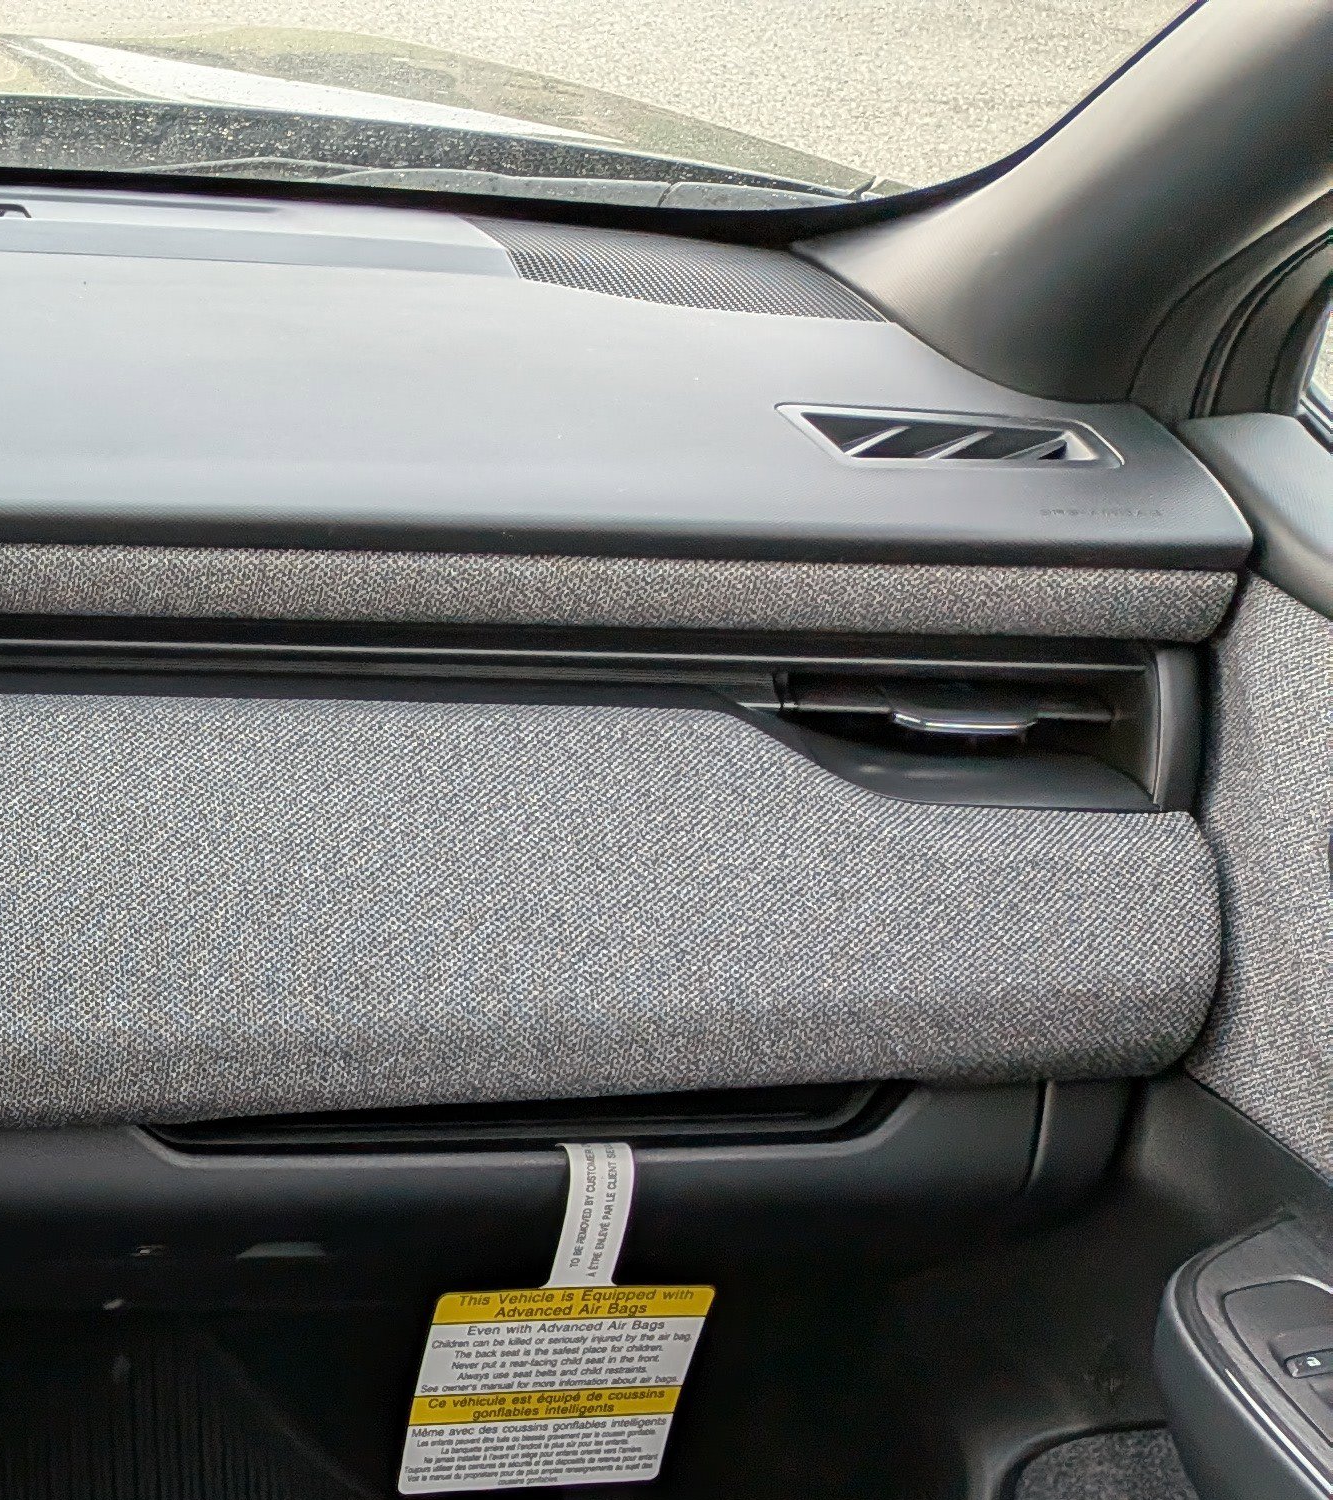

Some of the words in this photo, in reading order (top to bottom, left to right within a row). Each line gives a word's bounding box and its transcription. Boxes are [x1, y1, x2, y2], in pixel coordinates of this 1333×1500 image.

[584, 1147, 597, 1193] CUSTOMER
[607, 1161, 618, 1190] CLIENT
[584, 1195, 594, 1207] BY
[606, 1192, 616, 1203] LE
[602, 1204, 613, 1221] PAR
[573, 1246, 584, 1257] BE
[569, 1257, 581, 1269] TO
[459, 1295, 491, 1306] This
[498, 1291, 555, 1305] Vehicle
[561, 1290, 574, 1302] is
[581, 1288, 657, 1303] Equipped
[662, 1289, 694, 1300] with
[494, 1304, 573, 1318] Advanced
[578, 1303, 602, 1316] Air
[607, 1302, 647, 1317] Bags
[467, 1325, 501, 1336] Even
[506, 1324, 532, 1334] with
[537, 1321, 603, 1334] Advanced
[607, 1320, 627, 1331] Air
[631, 1320, 665, 1332] Bags
[431, 1340, 470, 1349] Children
[472, 1340, 490, 1348] can
[493, 1338, 505, 1346] be
[508, 1337, 532, 1346] killed
[547, 1335, 588, 1345] seriously
[591, 1334, 622, 1344] injured
[625, 1334, 637, 1343] by
[640, 1333, 655, 1341] the
[657, 1333, 671, 1341] air
[673, 1333, 692, 1342] bag.
[454, 1350, 472, 1359] The
[475, 1349, 497, 1358] back
[500, 1349, 521, 1357] seat
[523, 1348, 531, 1356] is
[534, 1347, 550, 1356] the
[552, 1346, 579, 1355] safest
[582, 1345, 608, 1355] place
[611, 1344, 624, 1353] for
[626, 1344, 664, 1352] children.
[451, 1361, 479, 1370] Never
[481, 1361, 498, 1370] put
[509, 1358, 558, 1368] rear-facing
[560, 1357, 582, 1366] child
[584, 1356, 606, 1365] seat
[607, 1356, 617, 1364] in
[619, 1355, 635, 1363] the
[637, 1354, 660, 1363] front.
[457, 1372, 490, 1382] Always
[512, 1370, 533, 1379] seat
[534, 1369, 557, 1378] belts
[559, 1367, 579, 1376] and
[580, 1366, 603, 1375] child
[604, 1365, 648, 1375] restraints.
[421, 1384, 439, 1393] See
[441, 1383, 477, 1393] owner's
[480, 1381, 515, 1391] manual
[516, 1380, 530, 1389] for
[532, 1380, 556, 1389] more
[558, 1377, 609, 1387] information
[611, 1376, 638, 1385] about
[639, 1376, 653, 1384] air
[428, 1398, 447, 1409] Ce
[453, 1396, 506, 1408] véhicule
[511, 1394, 533, 1404] est
[536, 1391, 581, 1406] équipé
[586, 1390, 603, 1402] de
[607, 1388, 666, 1401] coussins
[472, 1406, 540, 1421] gonflables
[544, 1402, 615, 1417] intelligents
[411, 1428, 445, 1438] Même
[448, 1427, 475, 1436] avec
[478, 1425, 498, 1435] des
[502, 1423, 549, 1434] coussins
[552, 1419, 607, 1432] gonflables
[611, 1417, 668, 1429] intelligents
